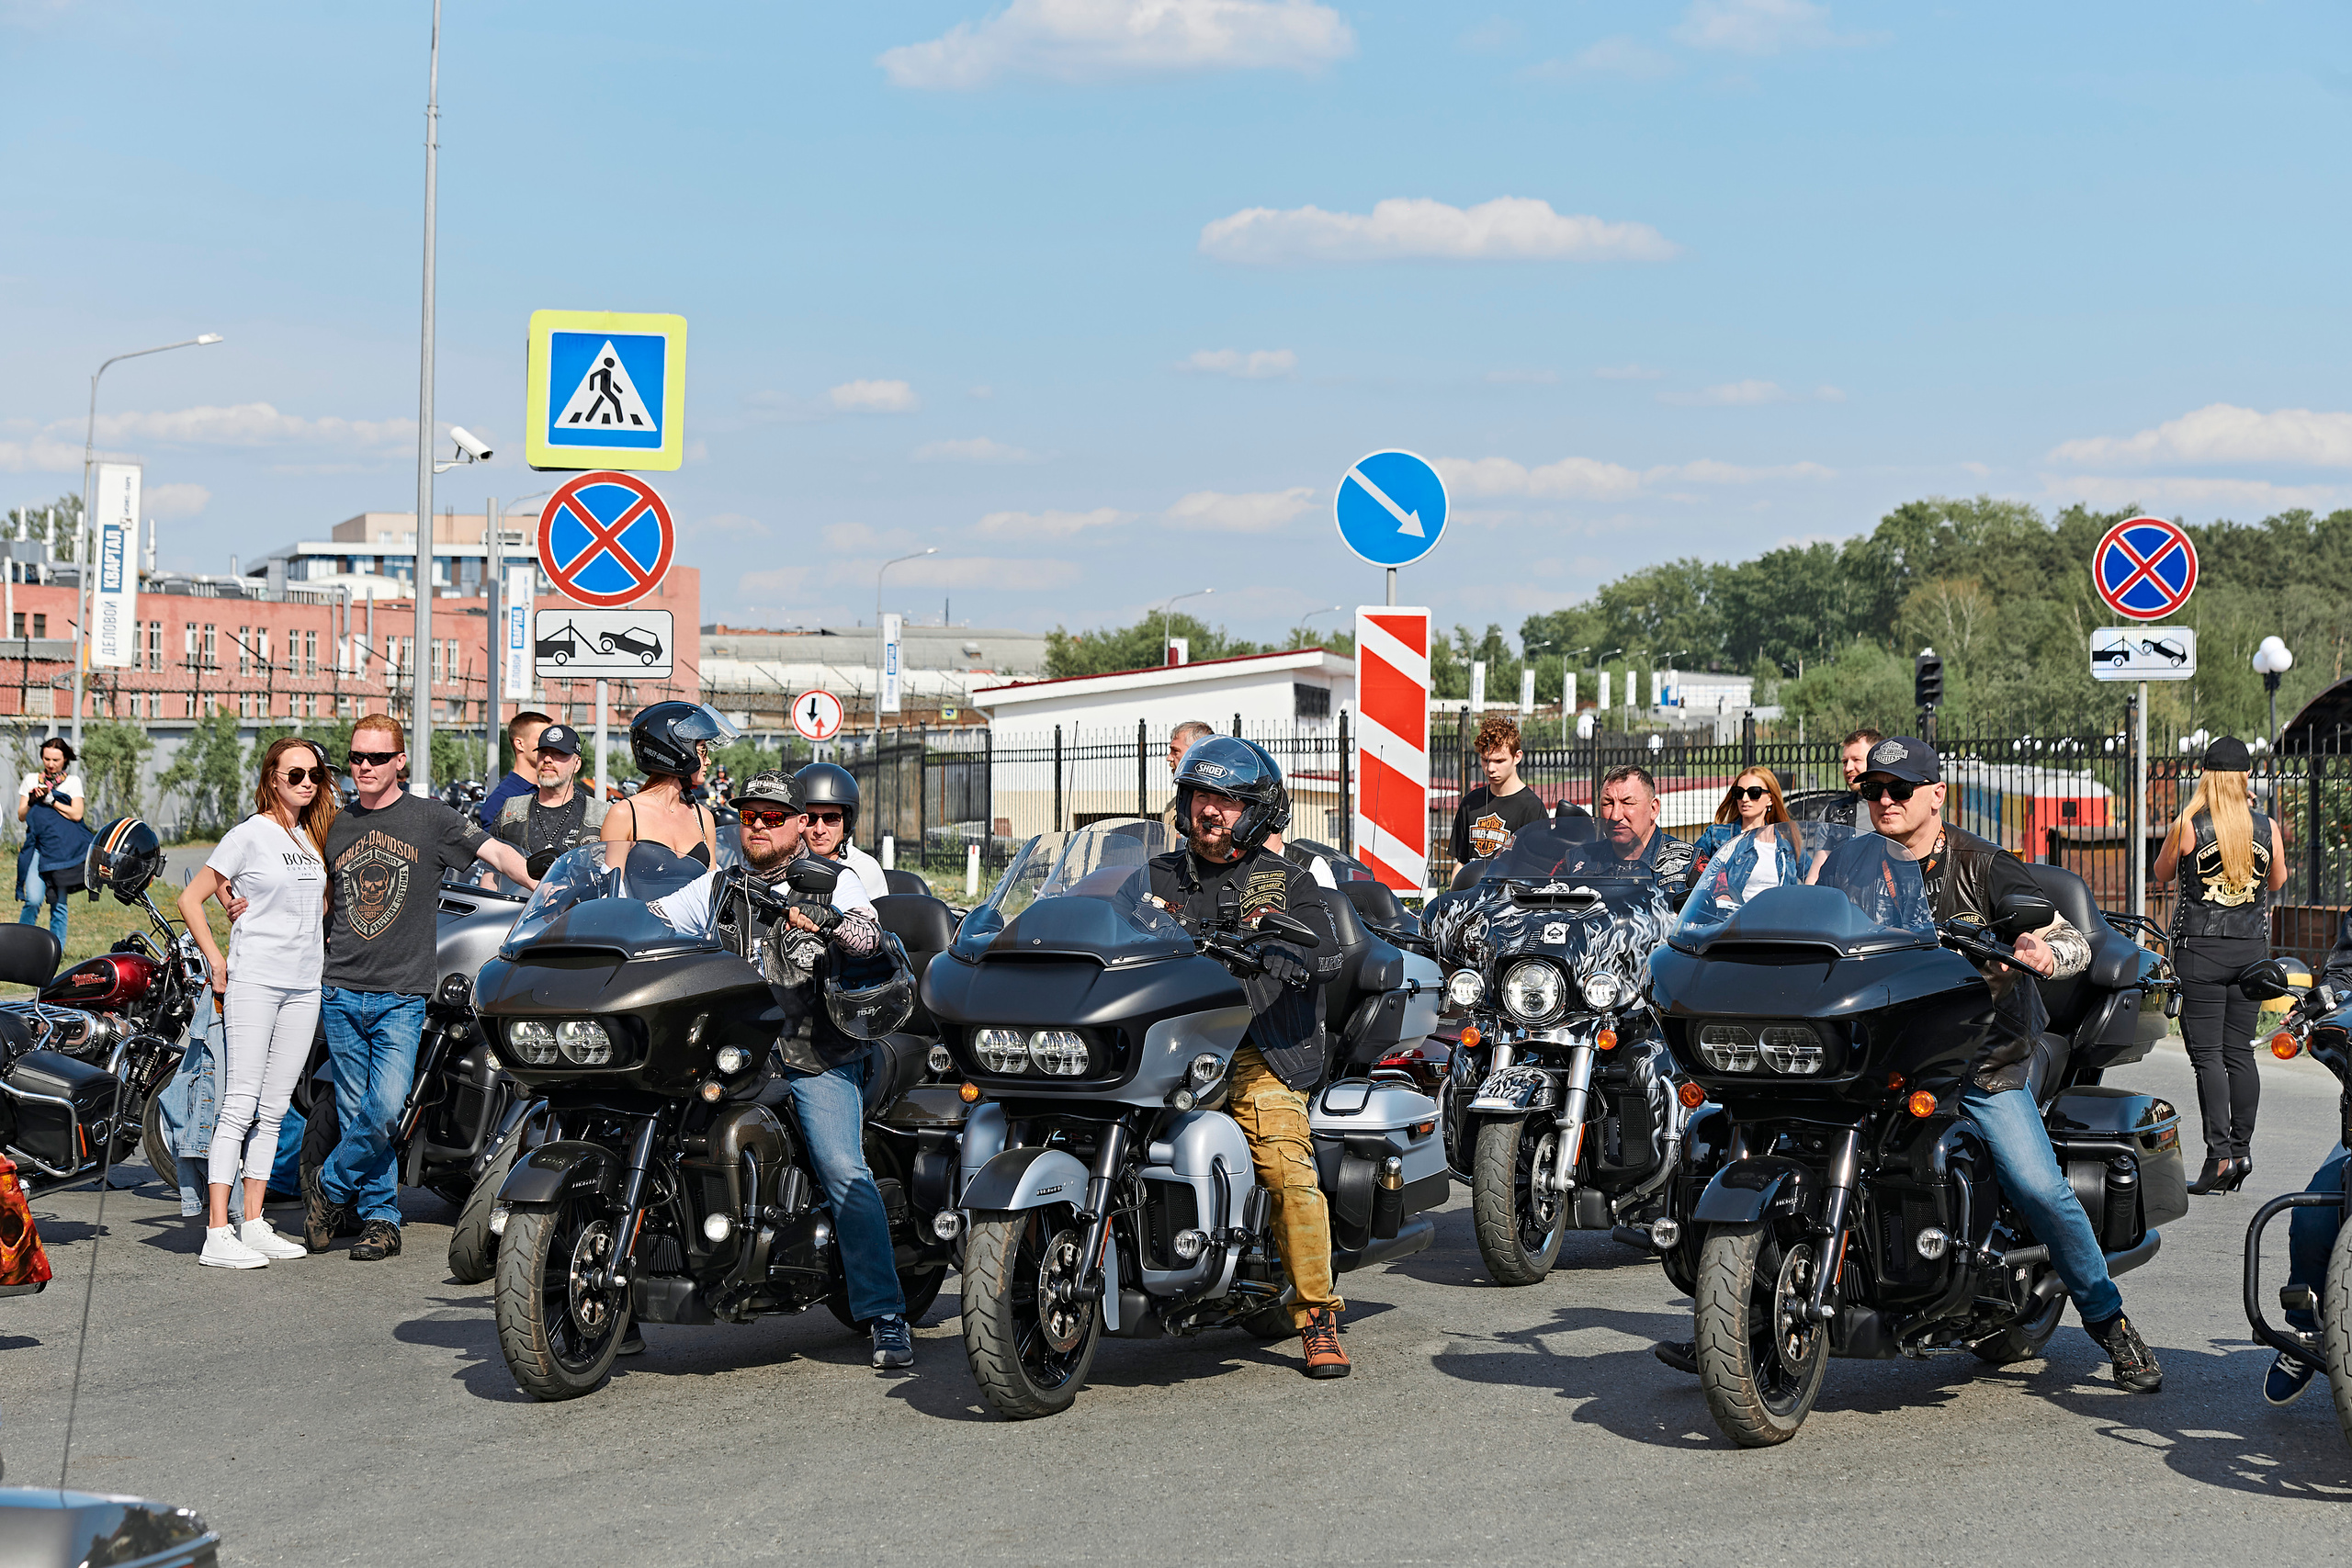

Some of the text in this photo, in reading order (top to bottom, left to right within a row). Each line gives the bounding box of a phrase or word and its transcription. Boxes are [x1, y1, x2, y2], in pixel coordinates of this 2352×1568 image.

[102, 529, 122, 657] ДЕЛОВОЙ КВАРТАЛ
[1198, 764, 1223, 776] SHOEI
[282, 852, 320, 865] BOSS
[335, 829, 418, 873] HARLEY-DAVIDSON
[349, 851, 372, 870] GENUINE
[377, 851, 399, 866] QUALITY
[372, 870, 408, 931] FACTORY CUSTOMS
[350, 906, 368, 931] ORIGINAL
[856, 1006, 882, 1017] Arai
